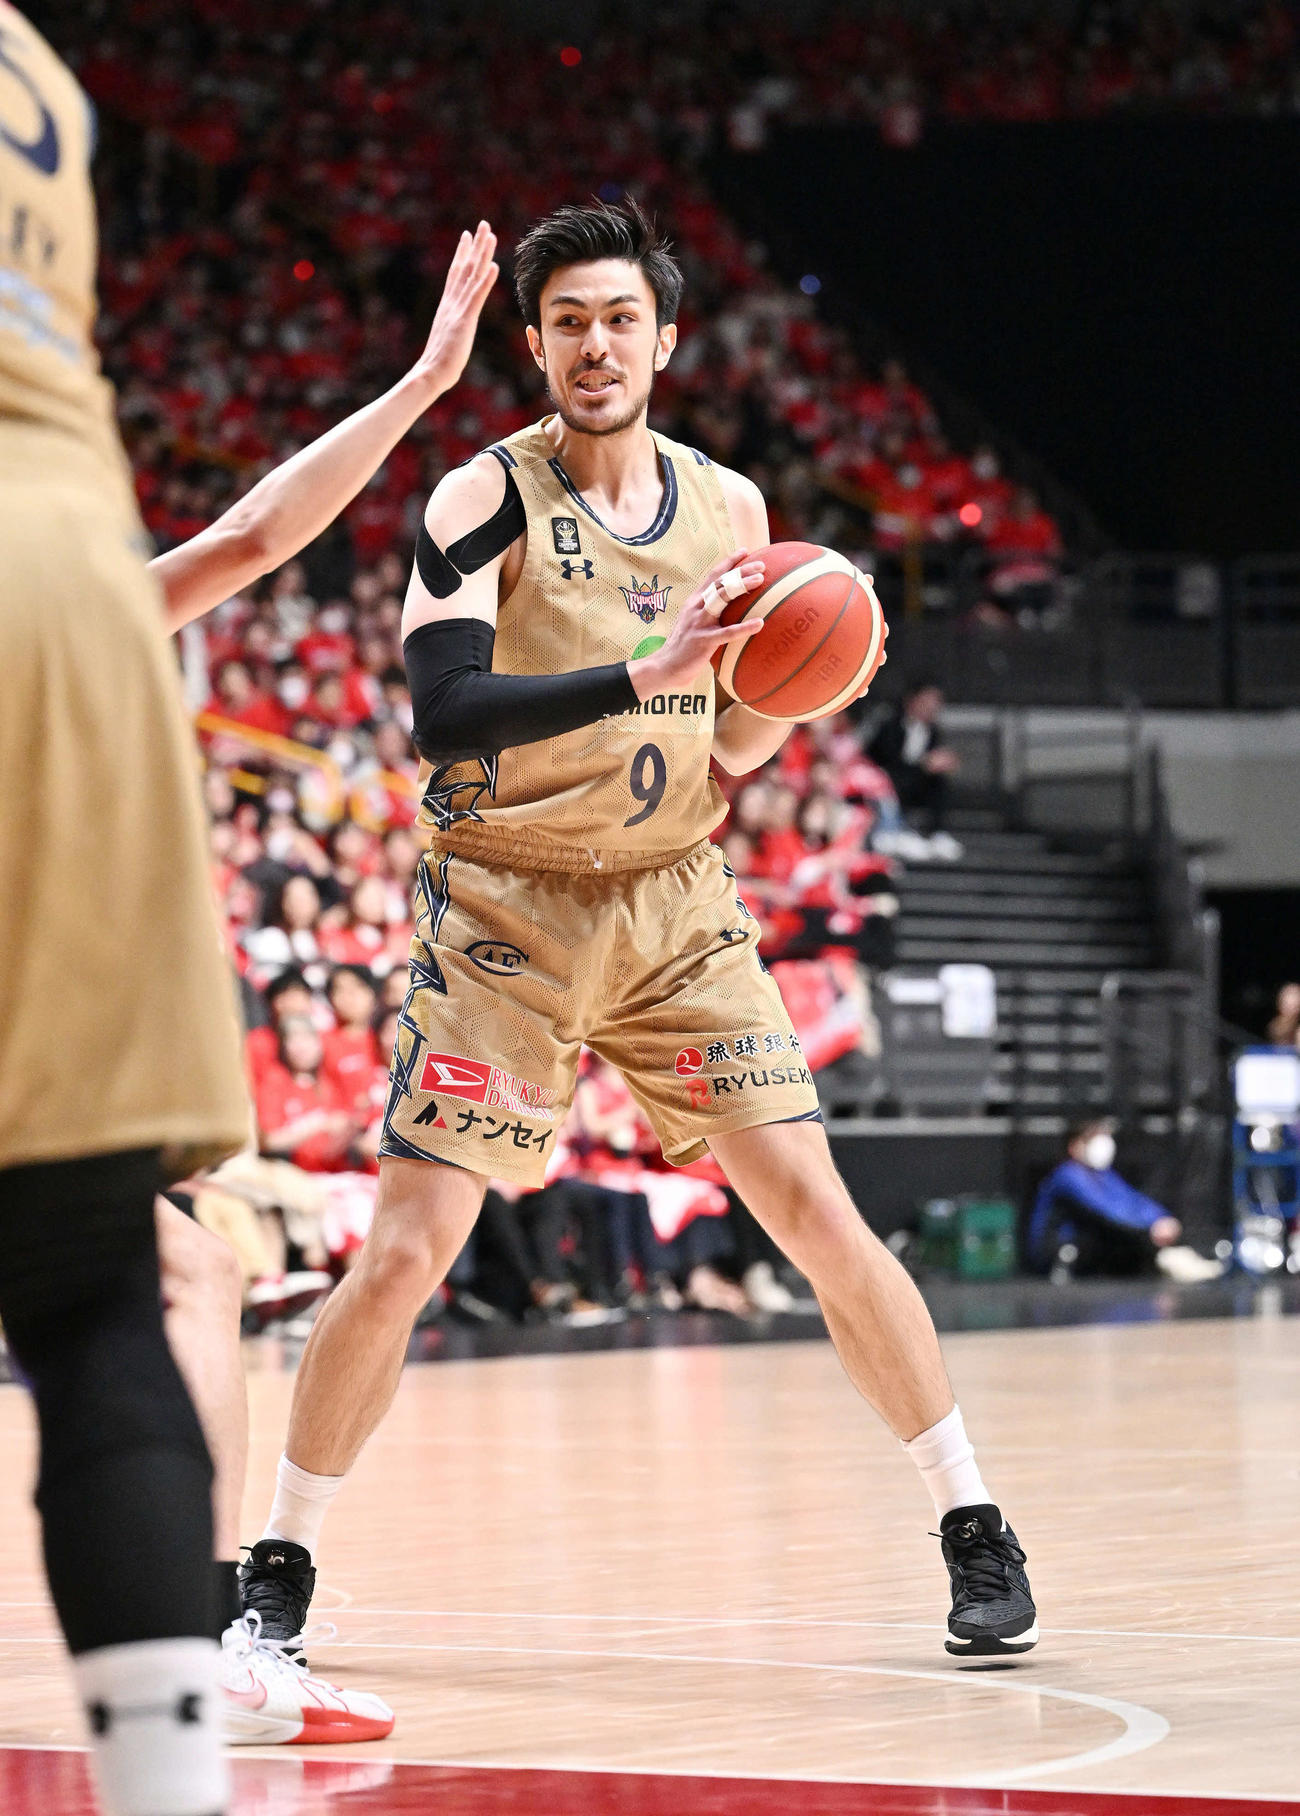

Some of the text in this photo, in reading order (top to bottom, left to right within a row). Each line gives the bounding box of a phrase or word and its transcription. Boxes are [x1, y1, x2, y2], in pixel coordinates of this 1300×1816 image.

[762, 607, 819, 672] molten
[623, 742, 667, 828] 9
[456, 1109, 553, 1153] ナンセイ
